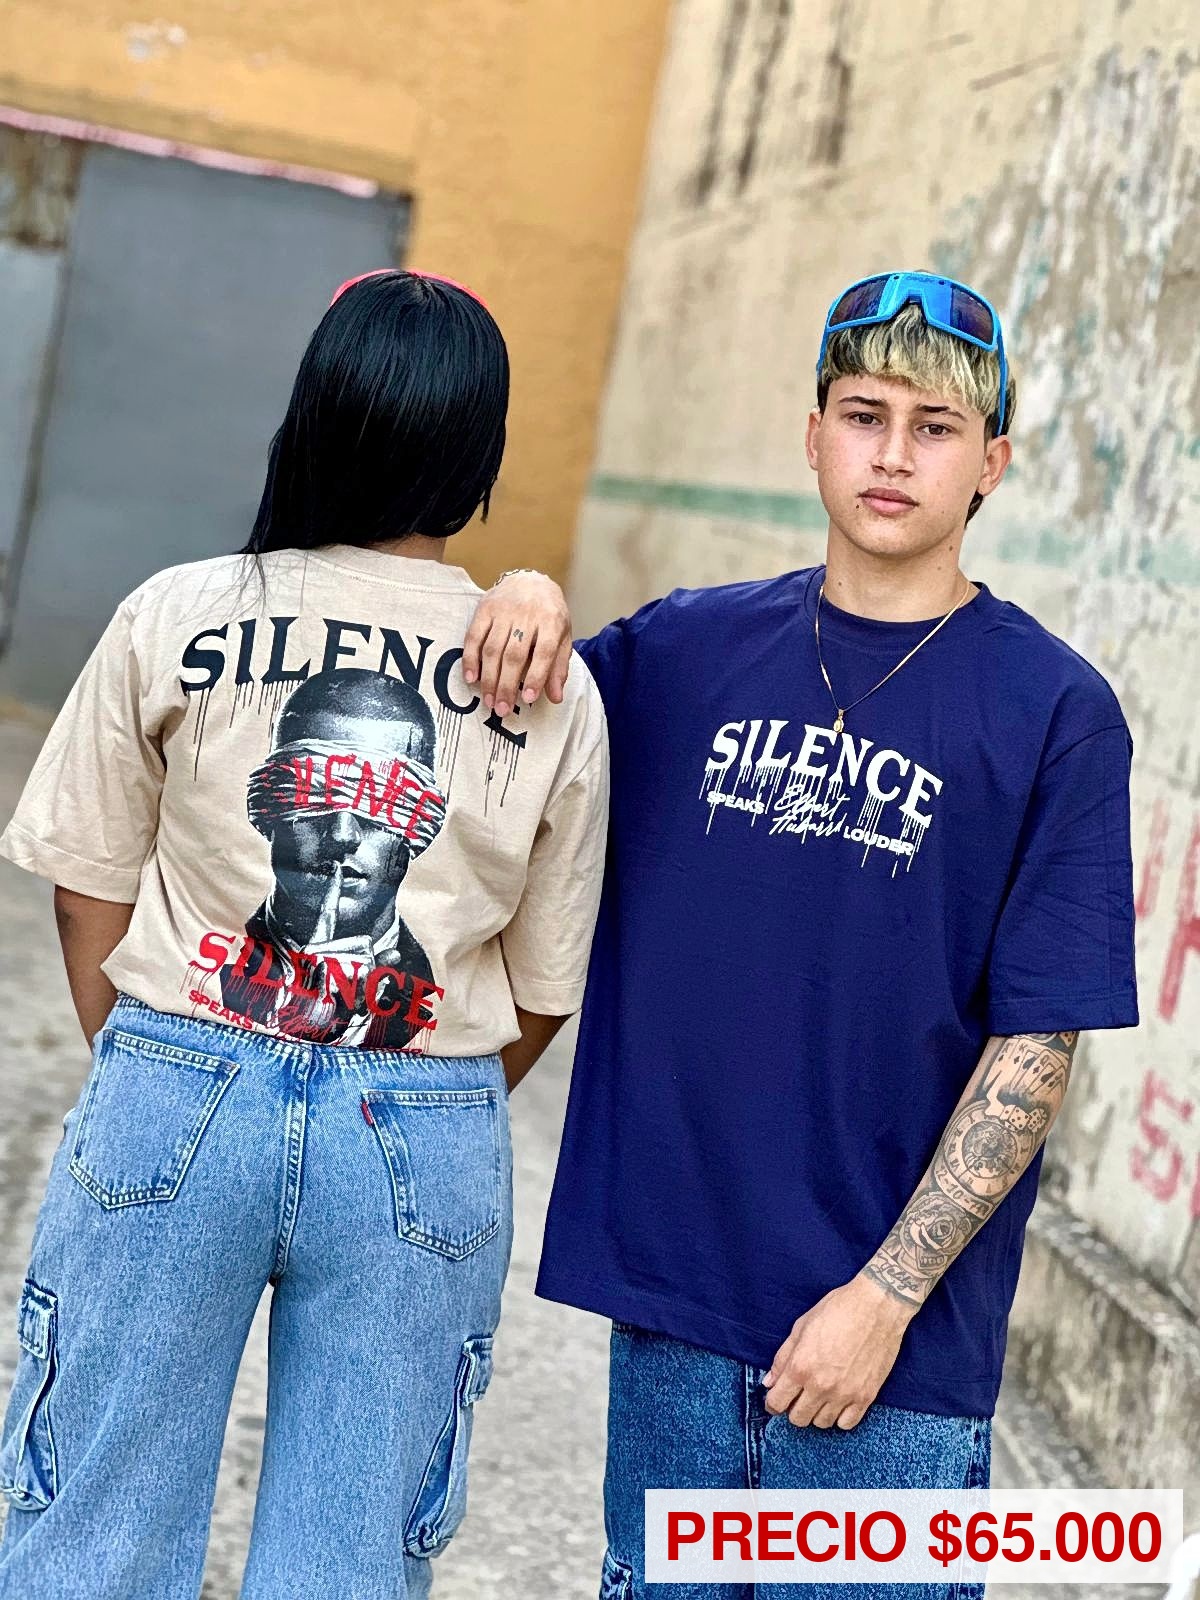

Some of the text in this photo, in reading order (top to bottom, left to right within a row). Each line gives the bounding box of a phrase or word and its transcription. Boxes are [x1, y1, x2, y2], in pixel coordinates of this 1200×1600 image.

[705, 720, 943, 828] SILENCE
[707, 790, 766, 815] SPEAKS
[843, 826, 915, 856] LOUDER
[188, 932, 445, 1031] SILENCE
[189, 990, 254, 1029] SPEAKS
